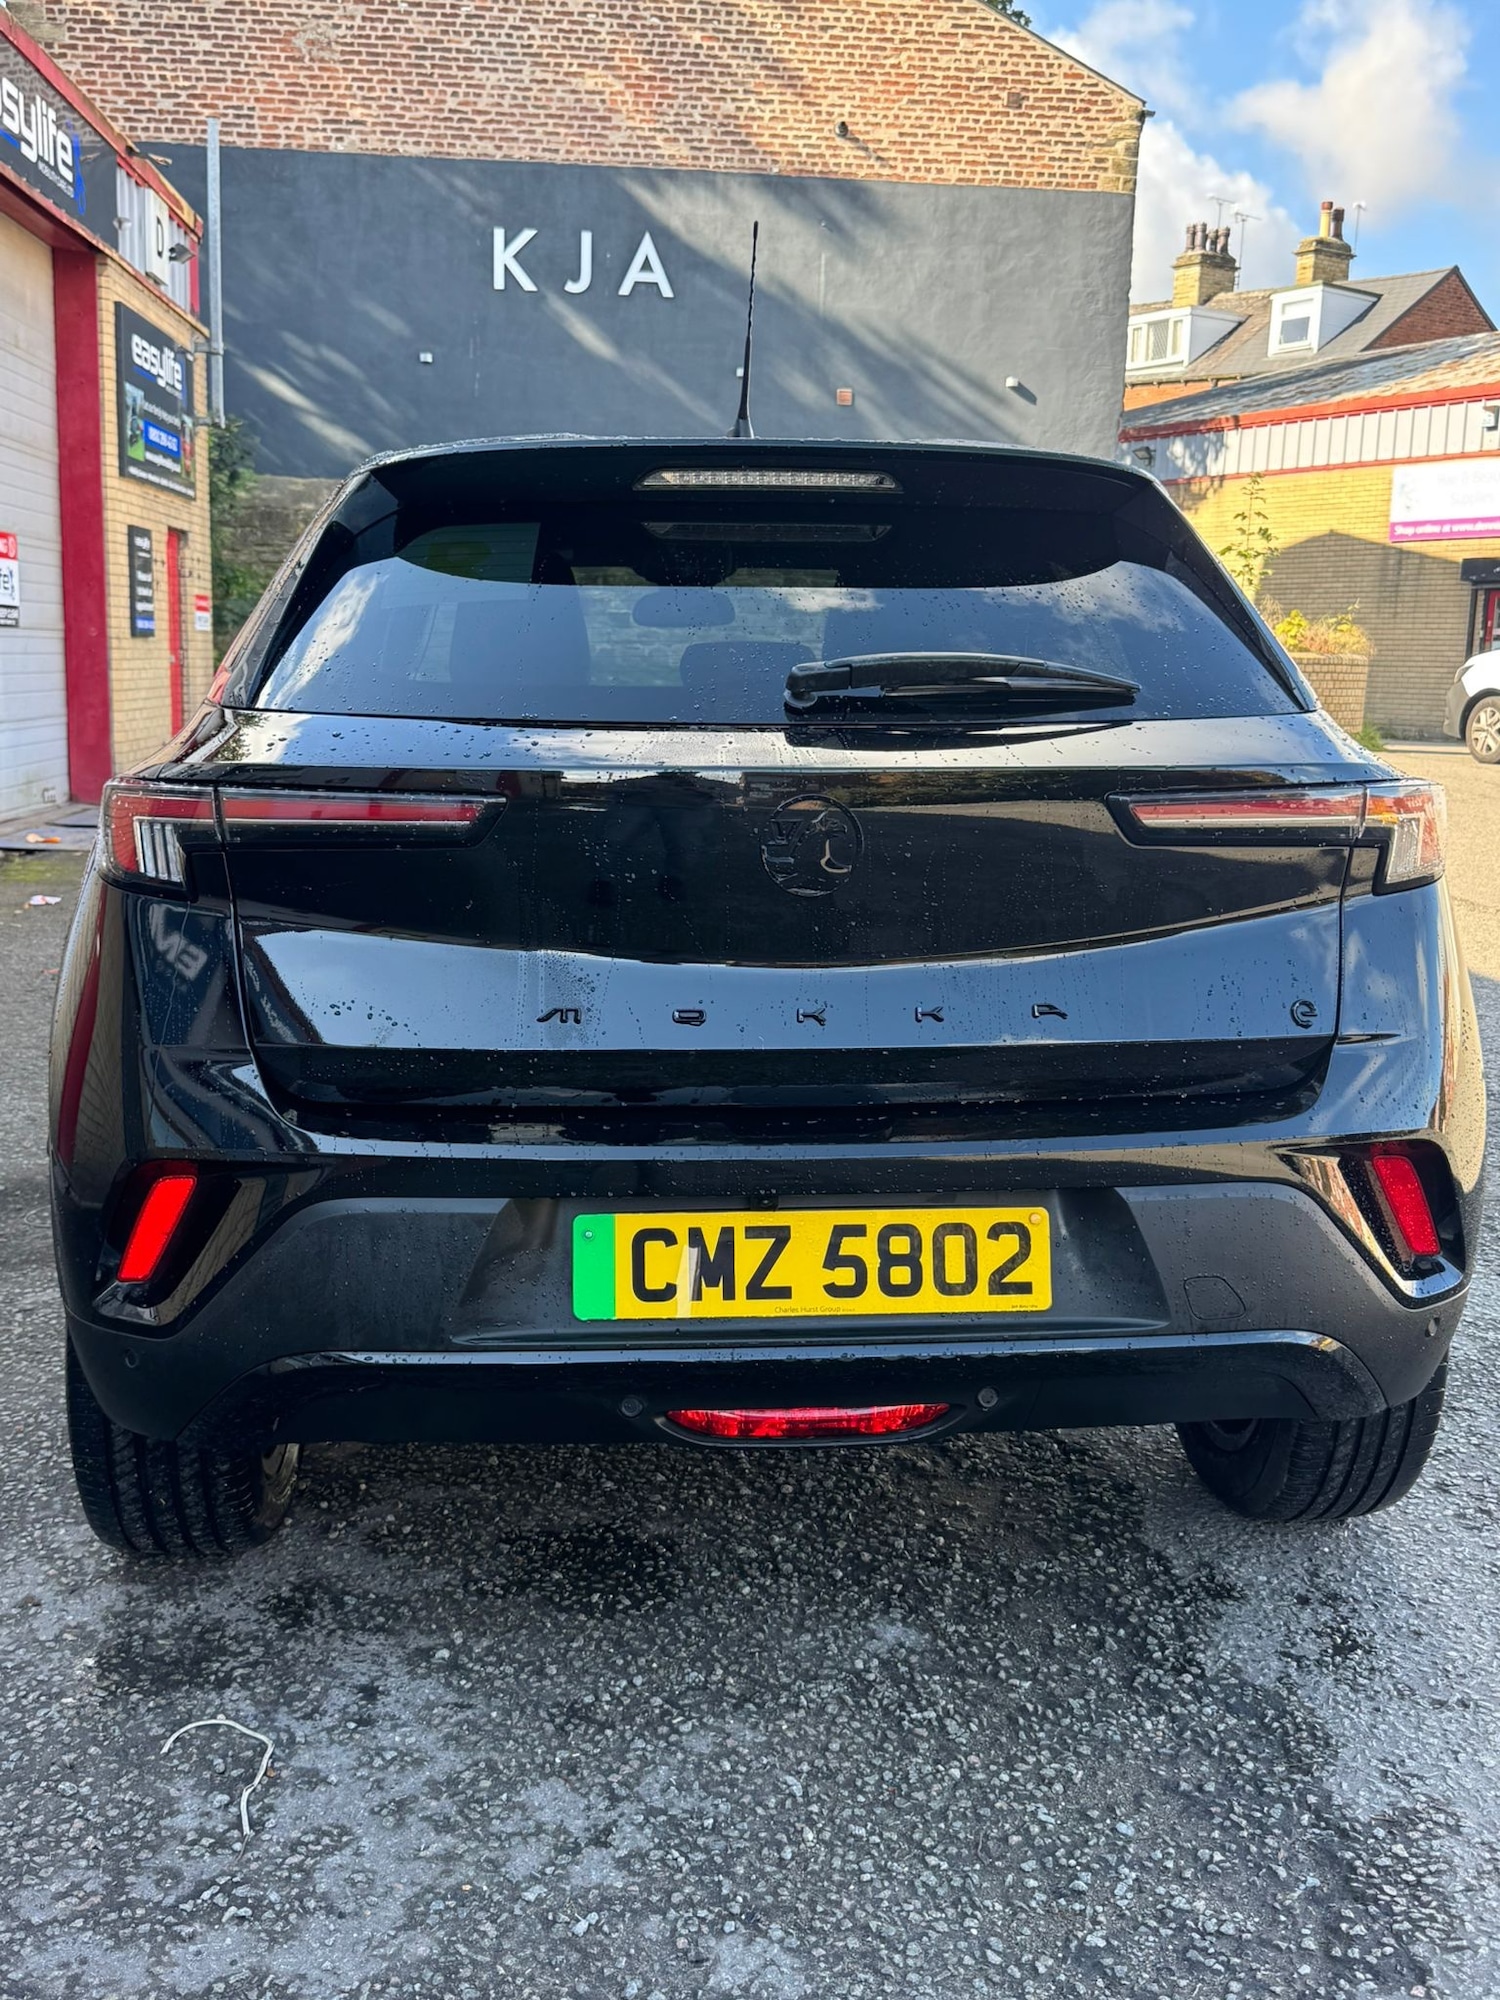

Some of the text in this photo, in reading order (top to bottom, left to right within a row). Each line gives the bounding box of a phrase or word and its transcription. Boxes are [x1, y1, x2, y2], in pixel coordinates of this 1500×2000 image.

[0, 77, 74, 184] sylife
[131, 333, 182, 391] easylife
[630, 1221, 1034, 1302] CMZ 5802
[774, 1306, 799, 1314] Charles
[820, 1305, 841, 1313] Group
